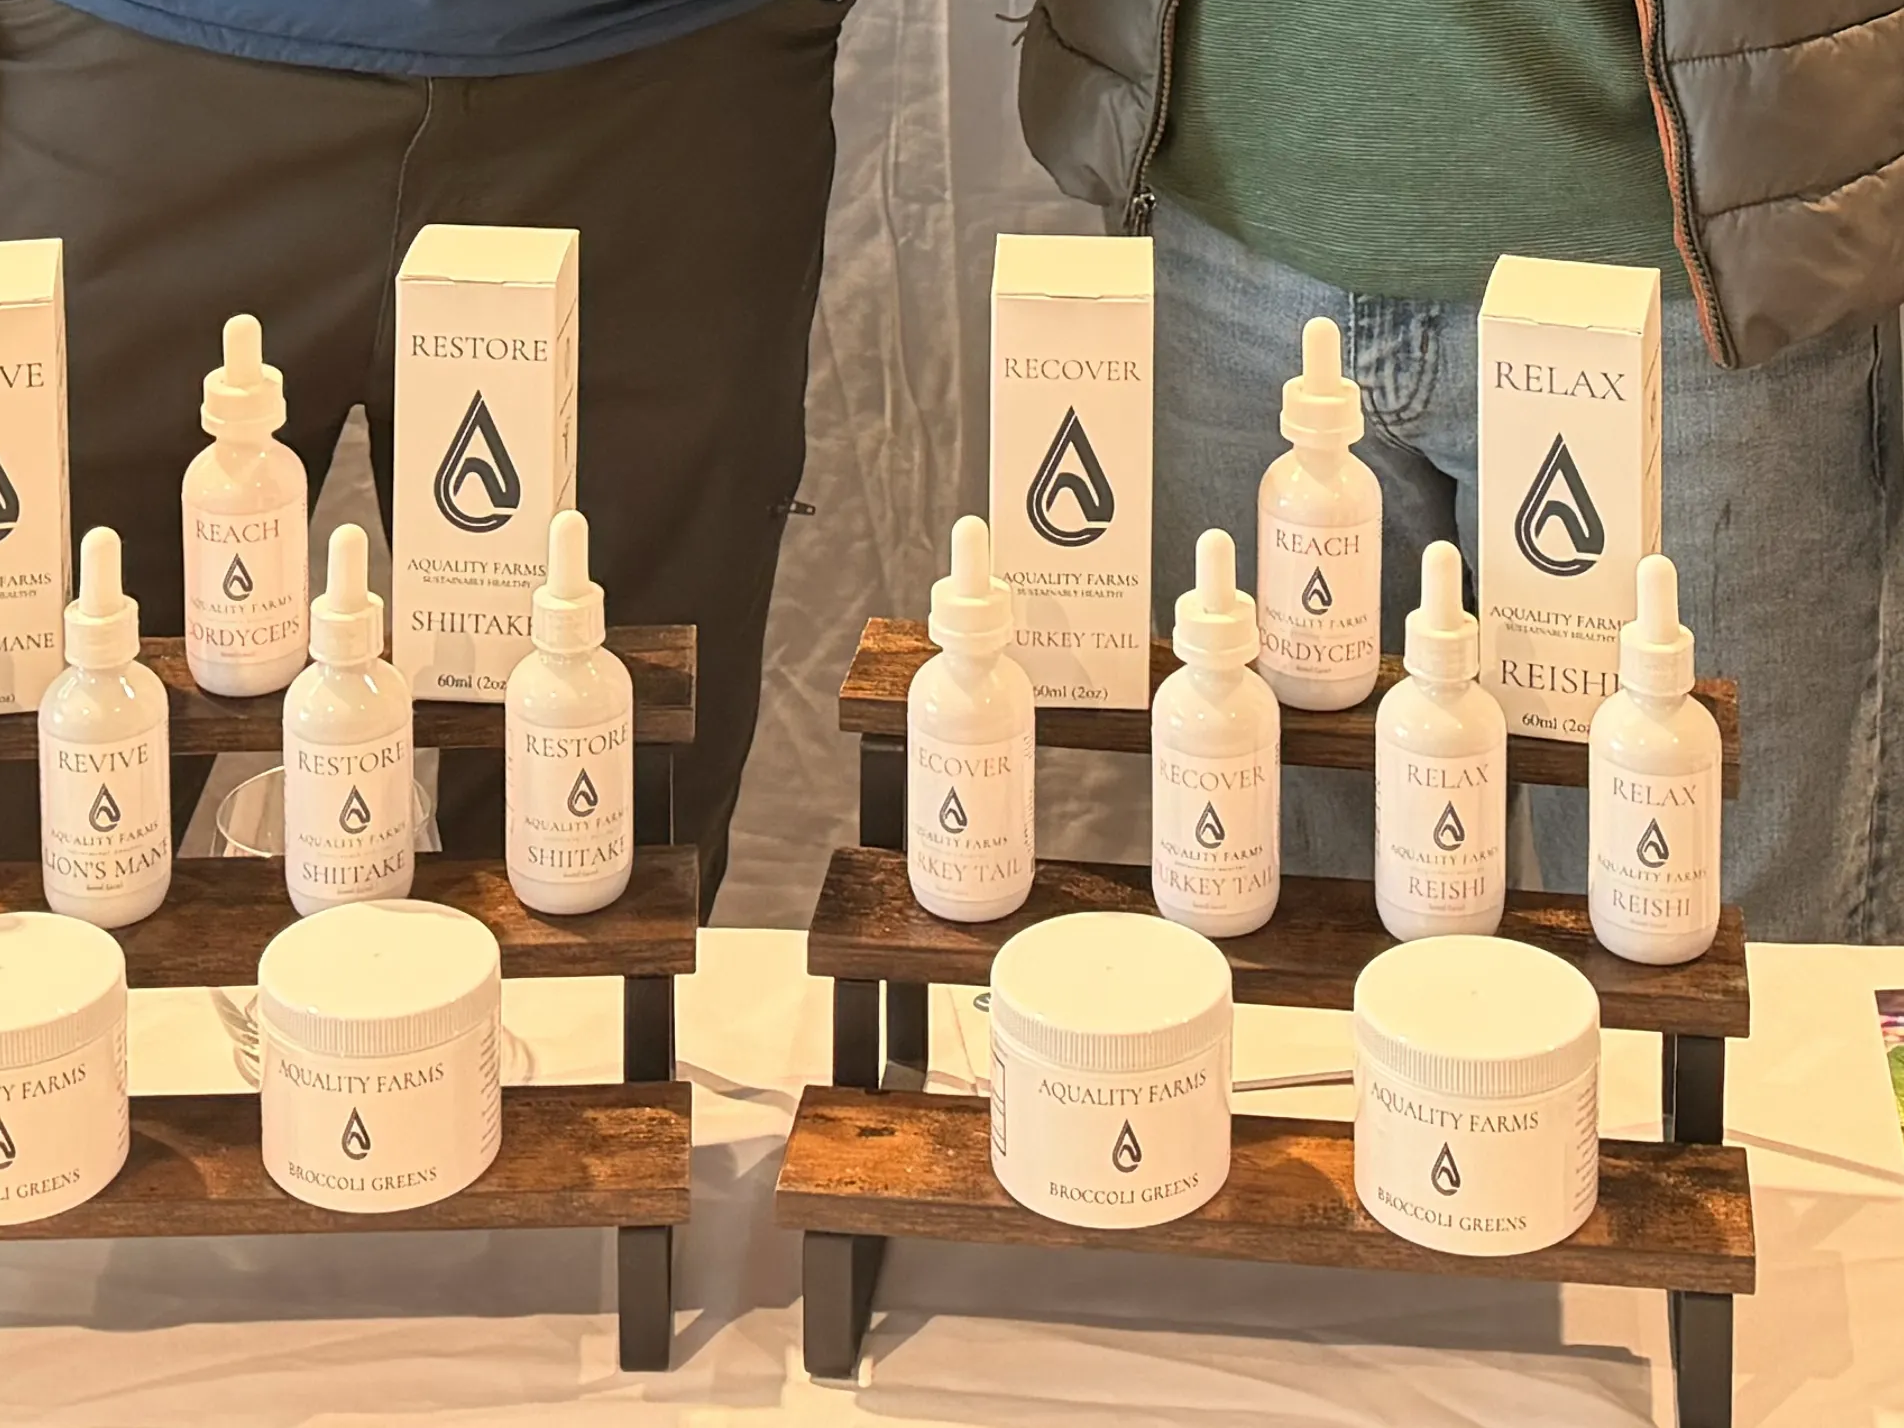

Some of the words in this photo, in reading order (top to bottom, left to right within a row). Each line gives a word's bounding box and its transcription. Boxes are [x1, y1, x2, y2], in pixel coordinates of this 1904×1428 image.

[411, 334, 548, 362] RESTORE
[1004, 357, 1142, 384] RECOVER
[1495, 360, 1627, 402] RELAX
[196, 519, 280, 544] REACH
[1276, 528, 1360, 557] REACH
[0, 573, 52, 585] FARMS
[407, 558, 488, 574] AQUALITY
[494, 562, 546, 577] FARMS
[1003, 572, 1082, 586] AQUALITY
[1087, 573, 1139, 586] FARMS
[1490, 605, 1572, 626] AQUALITY
[1016, 629, 1085, 648] URKEY
[1091, 632, 1139, 649] TAIL
[437, 674, 472, 689] 60ml
[477, 676, 507, 690] (2oz
[1071, 685, 1108, 700] (2oz)
[1522, 712, 1557, 730] 60ml
[526, 722, 628, 759] RESTORE
[59, 743, 149, 773] REVIVE
[298, 740, 405, 776] RESTORE
[918, 746, 1012, 778] ECOVER
[1159, 758, 1266, 792] RECOVER
[1407, 763, 1489, 789] RELAX
[1613, 776, 1696, 807] RELAX
[302, 849, 406, 885] SHIITAKE
[1408, 876, 1485, 900] REISHI
[1612, 888, 1690, 918] REISHI
[22, 1063, 86, 1100] FARMS
[278, 1059, 370, 1094] AQUALITY
[376, 1062, 444, 1094] FARMS
[1038, 1079, 1142, 1106] AQUALITY
[1149, 1069, 1207, 1104] FARMS
[1371, 1081, 1463, 1131] AQUALITY
[1469, 1111, 1539, 1133] FARMS
[16, 1168, 80, 1199] GREENS
[288, 1161, 364, 1191] BROCCOLI
[371, 1166, 437, 1191] GREENS
[1049, 1181, 1134, 1205] BROCCOLI
[1142, 1173, 1199, 1203] GREENS
[1377, 1187, 1452, 1227] BROCCOLI
[1459, 1216, 1527, 1232] GREENS
